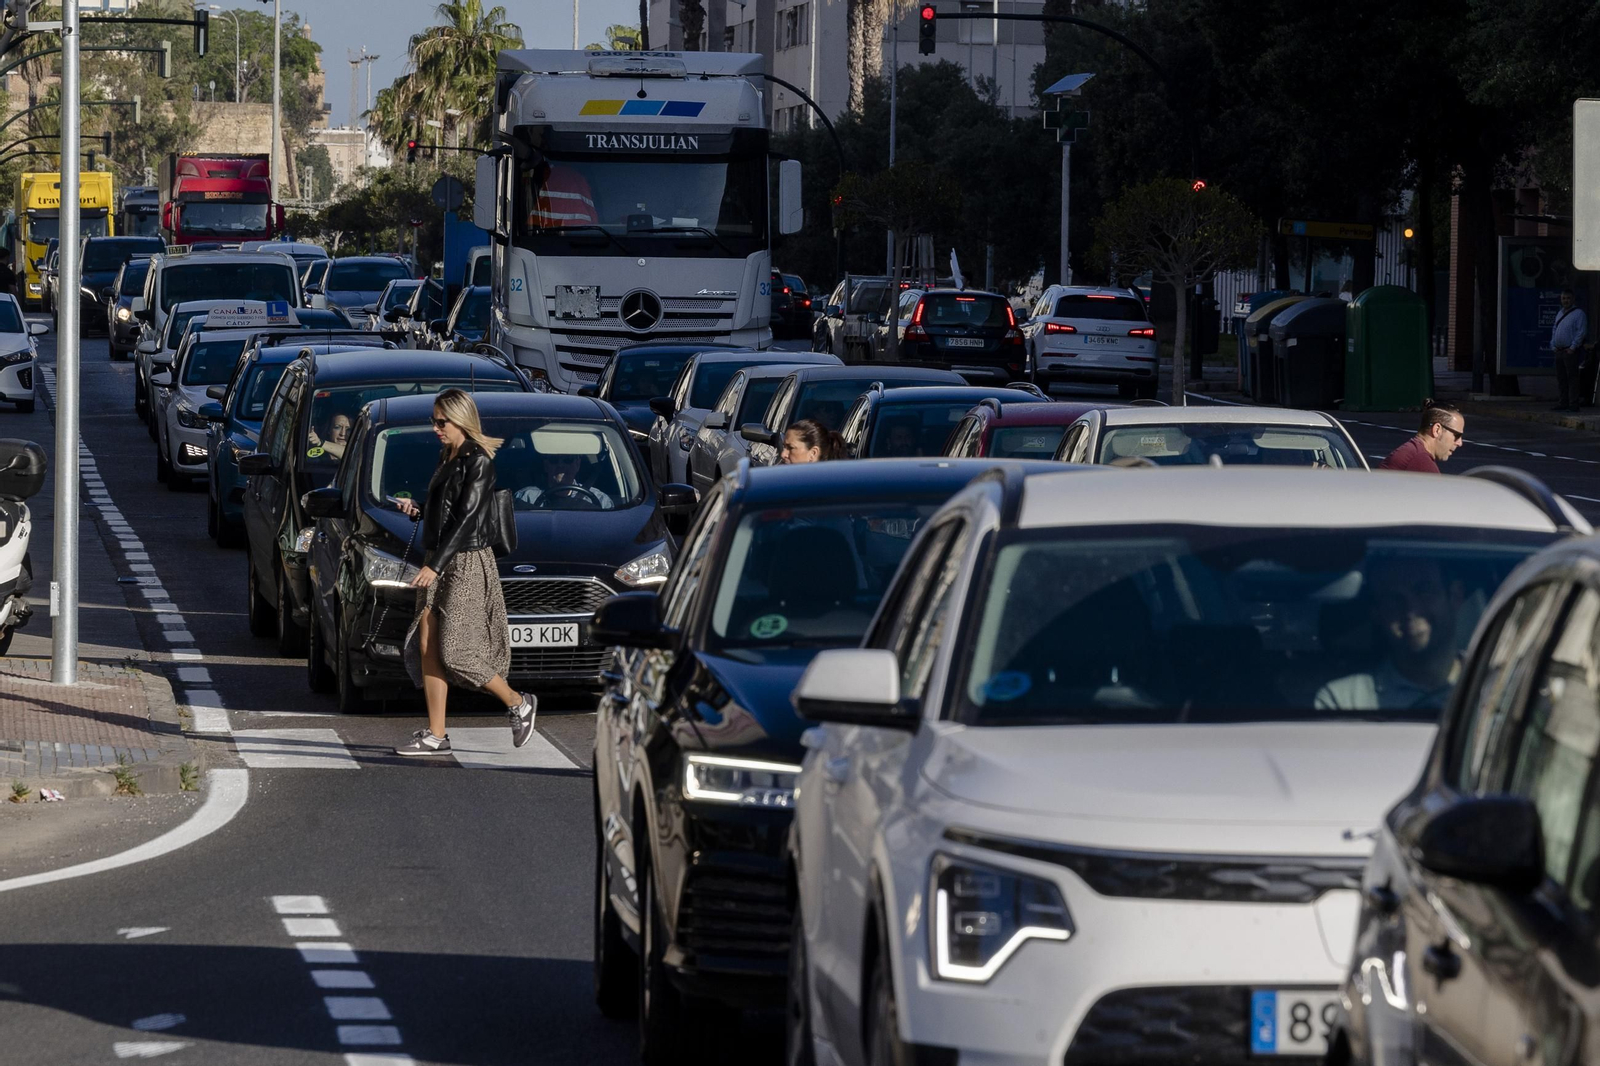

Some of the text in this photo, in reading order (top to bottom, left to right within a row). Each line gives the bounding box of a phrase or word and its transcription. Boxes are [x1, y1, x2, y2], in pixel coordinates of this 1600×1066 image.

[586, 134, 699, 149] TRANSJULIAN
[1339, 227, 1372, 237] Parking
[510, 278, 522, 292] 32
[759, 282, 771, 296] 32
[213, 307, 263, 315] CANALEJAS
[272, 303, 283, 315] L
[511, 626, 574, 643] 03 KDK
[1290, 1002, 1337, 1043] 89
